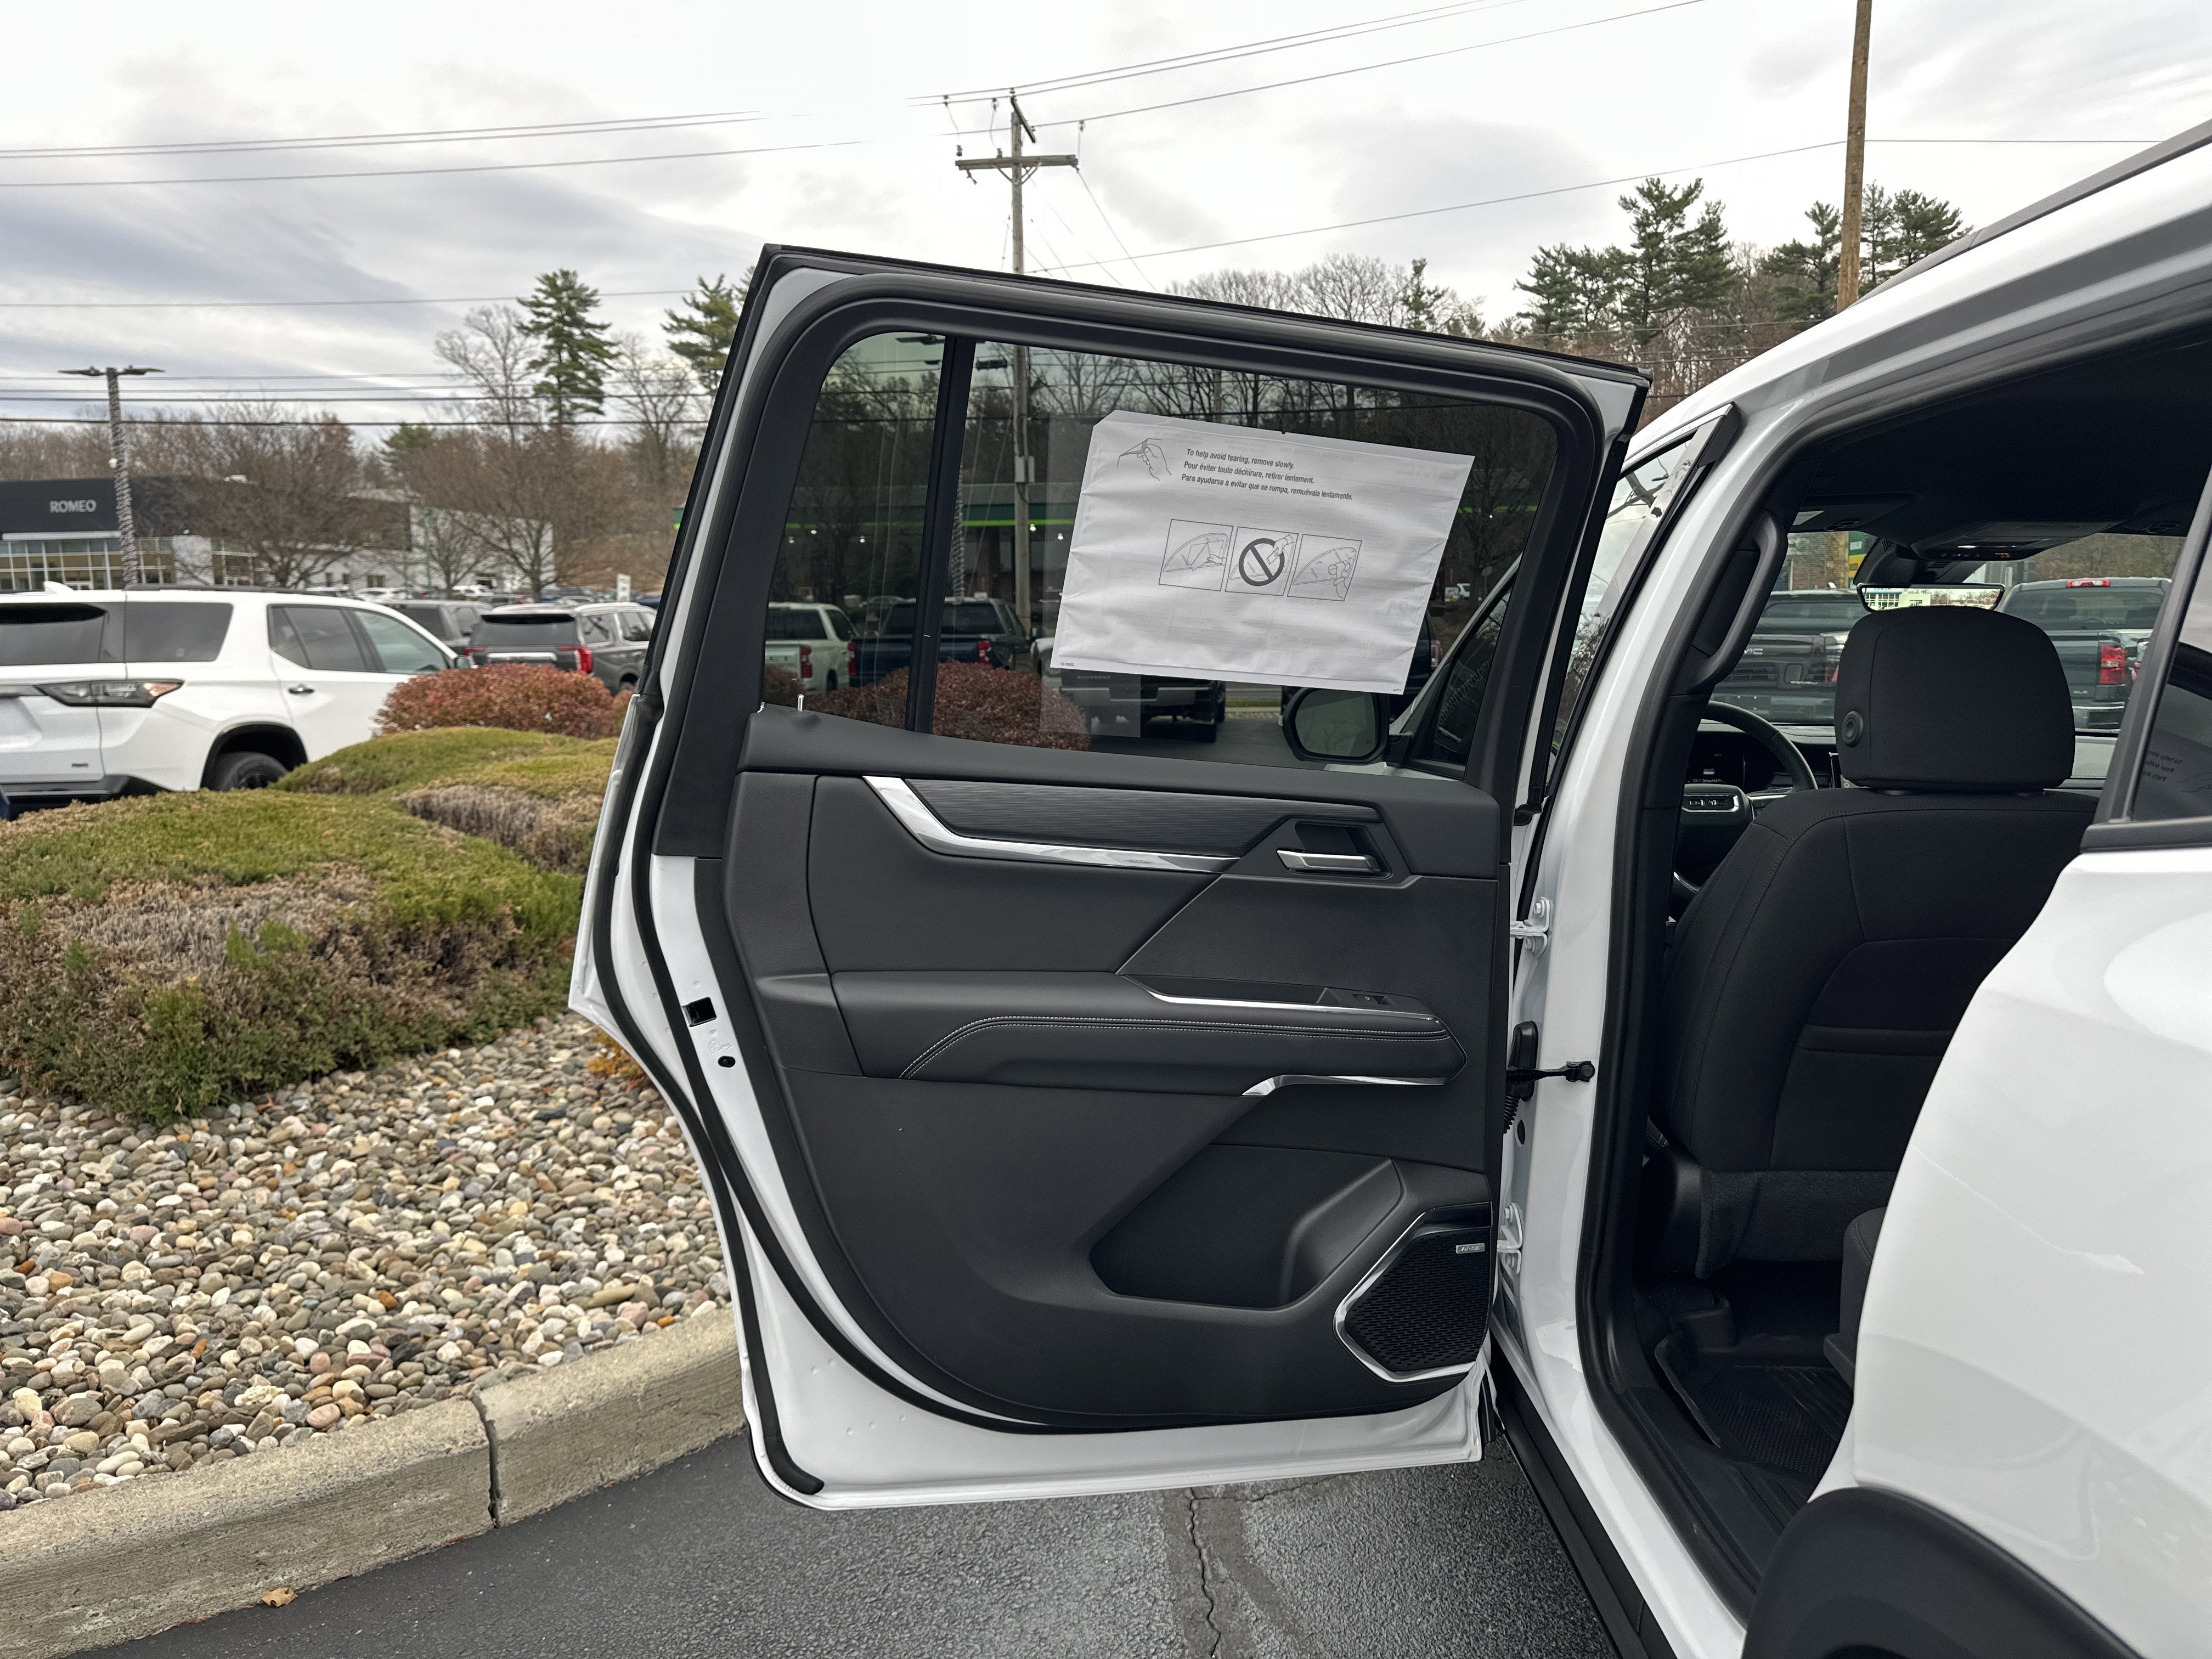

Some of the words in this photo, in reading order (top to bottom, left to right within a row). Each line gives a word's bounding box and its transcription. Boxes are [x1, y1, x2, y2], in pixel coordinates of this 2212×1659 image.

[1195, 450, 1209, 459] help
[1228, 454, 1250, 464] tearing,
[1251, 458, 1273, 466] remove
[1275, 460, 1295, 470] slowly.
[1184, 461, 1198, 470] Pour
[1199, 463, 1217, 472] éviter
[1234, 468, 1263, 479] déchirure,
[1265, 472, 1284, 481] retirer
[1285, 474, 1314, 484] lentement.
[1182, 473, 1195, 482] Para
[1197, 477, 1224, 486] ayudarse
[1269, 485, 1289, 494] rompa,
[1290, 488, 1320, 496] remuévala
[1321, 490, 1353, 500] lentamente.
[50, 499, 97, 513] ROMEO
